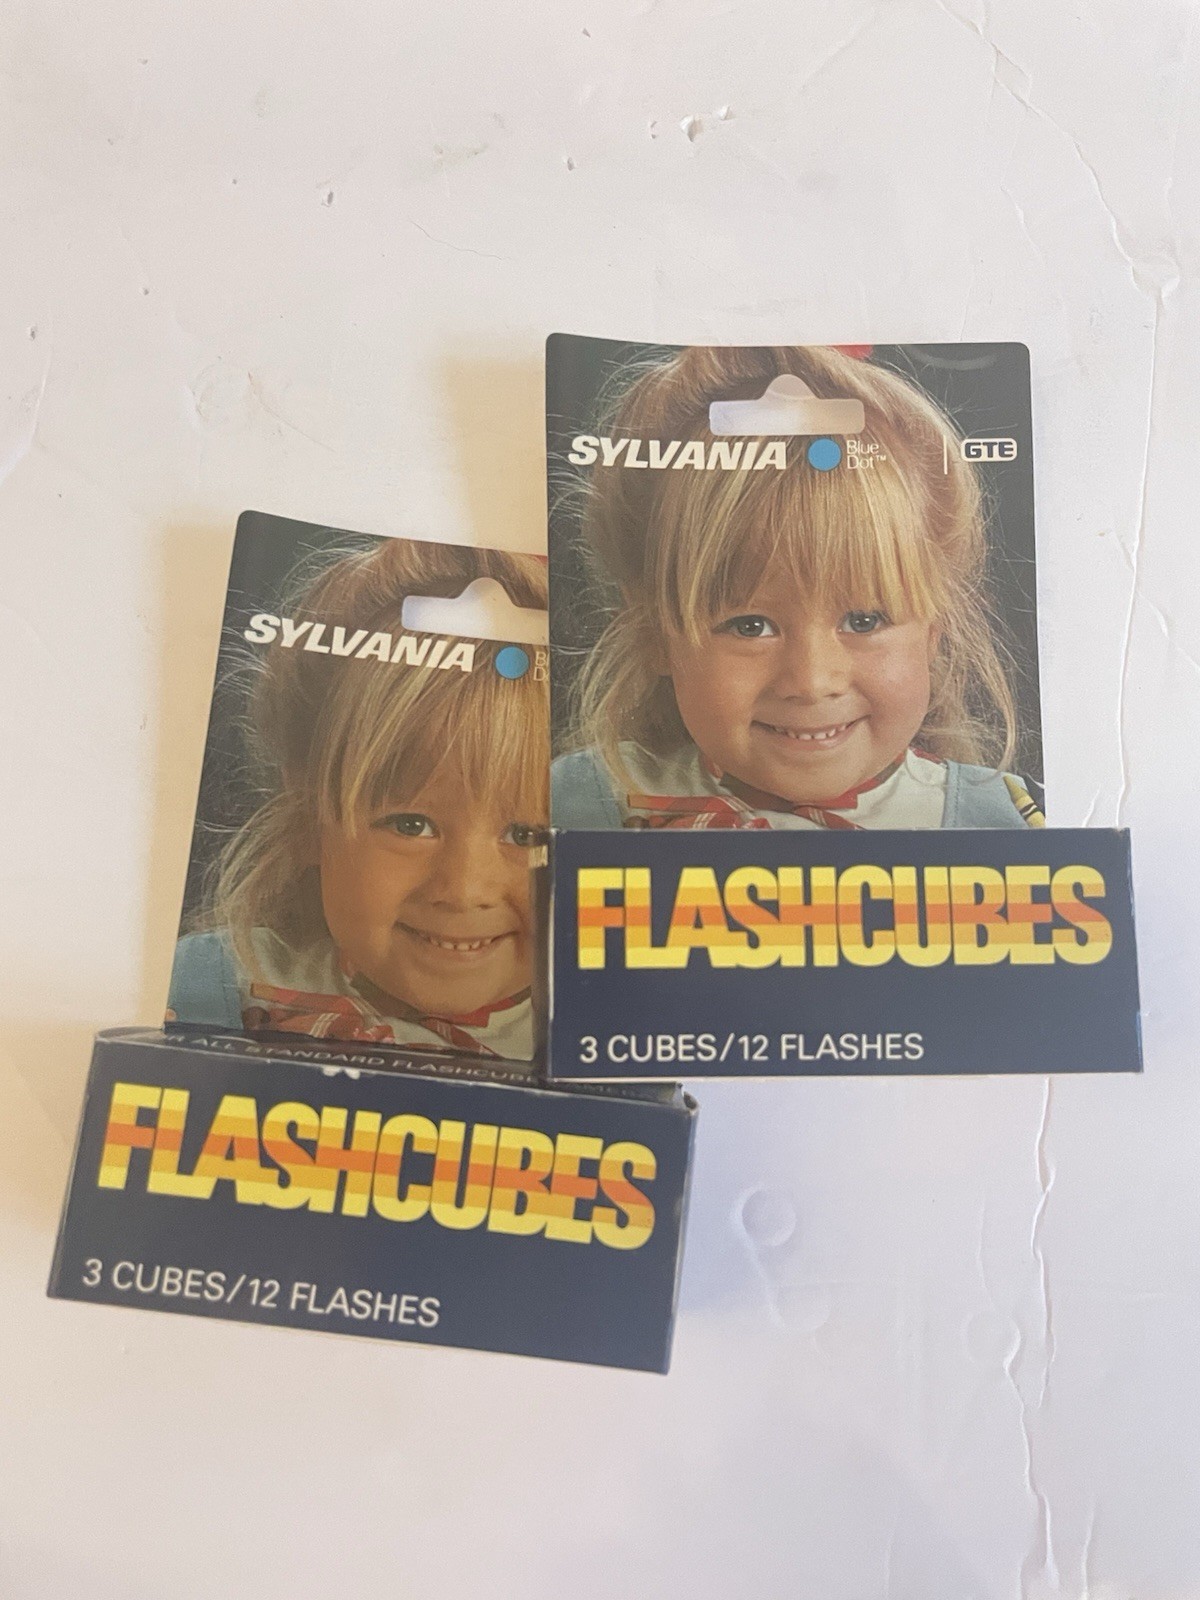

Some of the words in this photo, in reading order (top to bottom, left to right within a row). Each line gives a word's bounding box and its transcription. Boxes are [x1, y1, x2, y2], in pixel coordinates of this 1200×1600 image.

[567, 435, 788, 471] SYLVANIA
[846, 439, 880, 456] Blue
[963, 440, 1015, 460] GTE
[243, 613, 476, 673] SYLVANIA
[576, 864, 1113, 970] FLASHCUBES
[579, 1034, 599, 1064] 3
[606, 1031, 770, 1064] CUBES/12
[779, 1031, 926, 1062] FLASHES
[97, 1081, 658, 1250] FLASHCUBES
[81, 1257, 104, 1288] 3
[111, 1261, 281, 1310] CUBES/12
[289, 1281, 442, 1328] FLASHES
